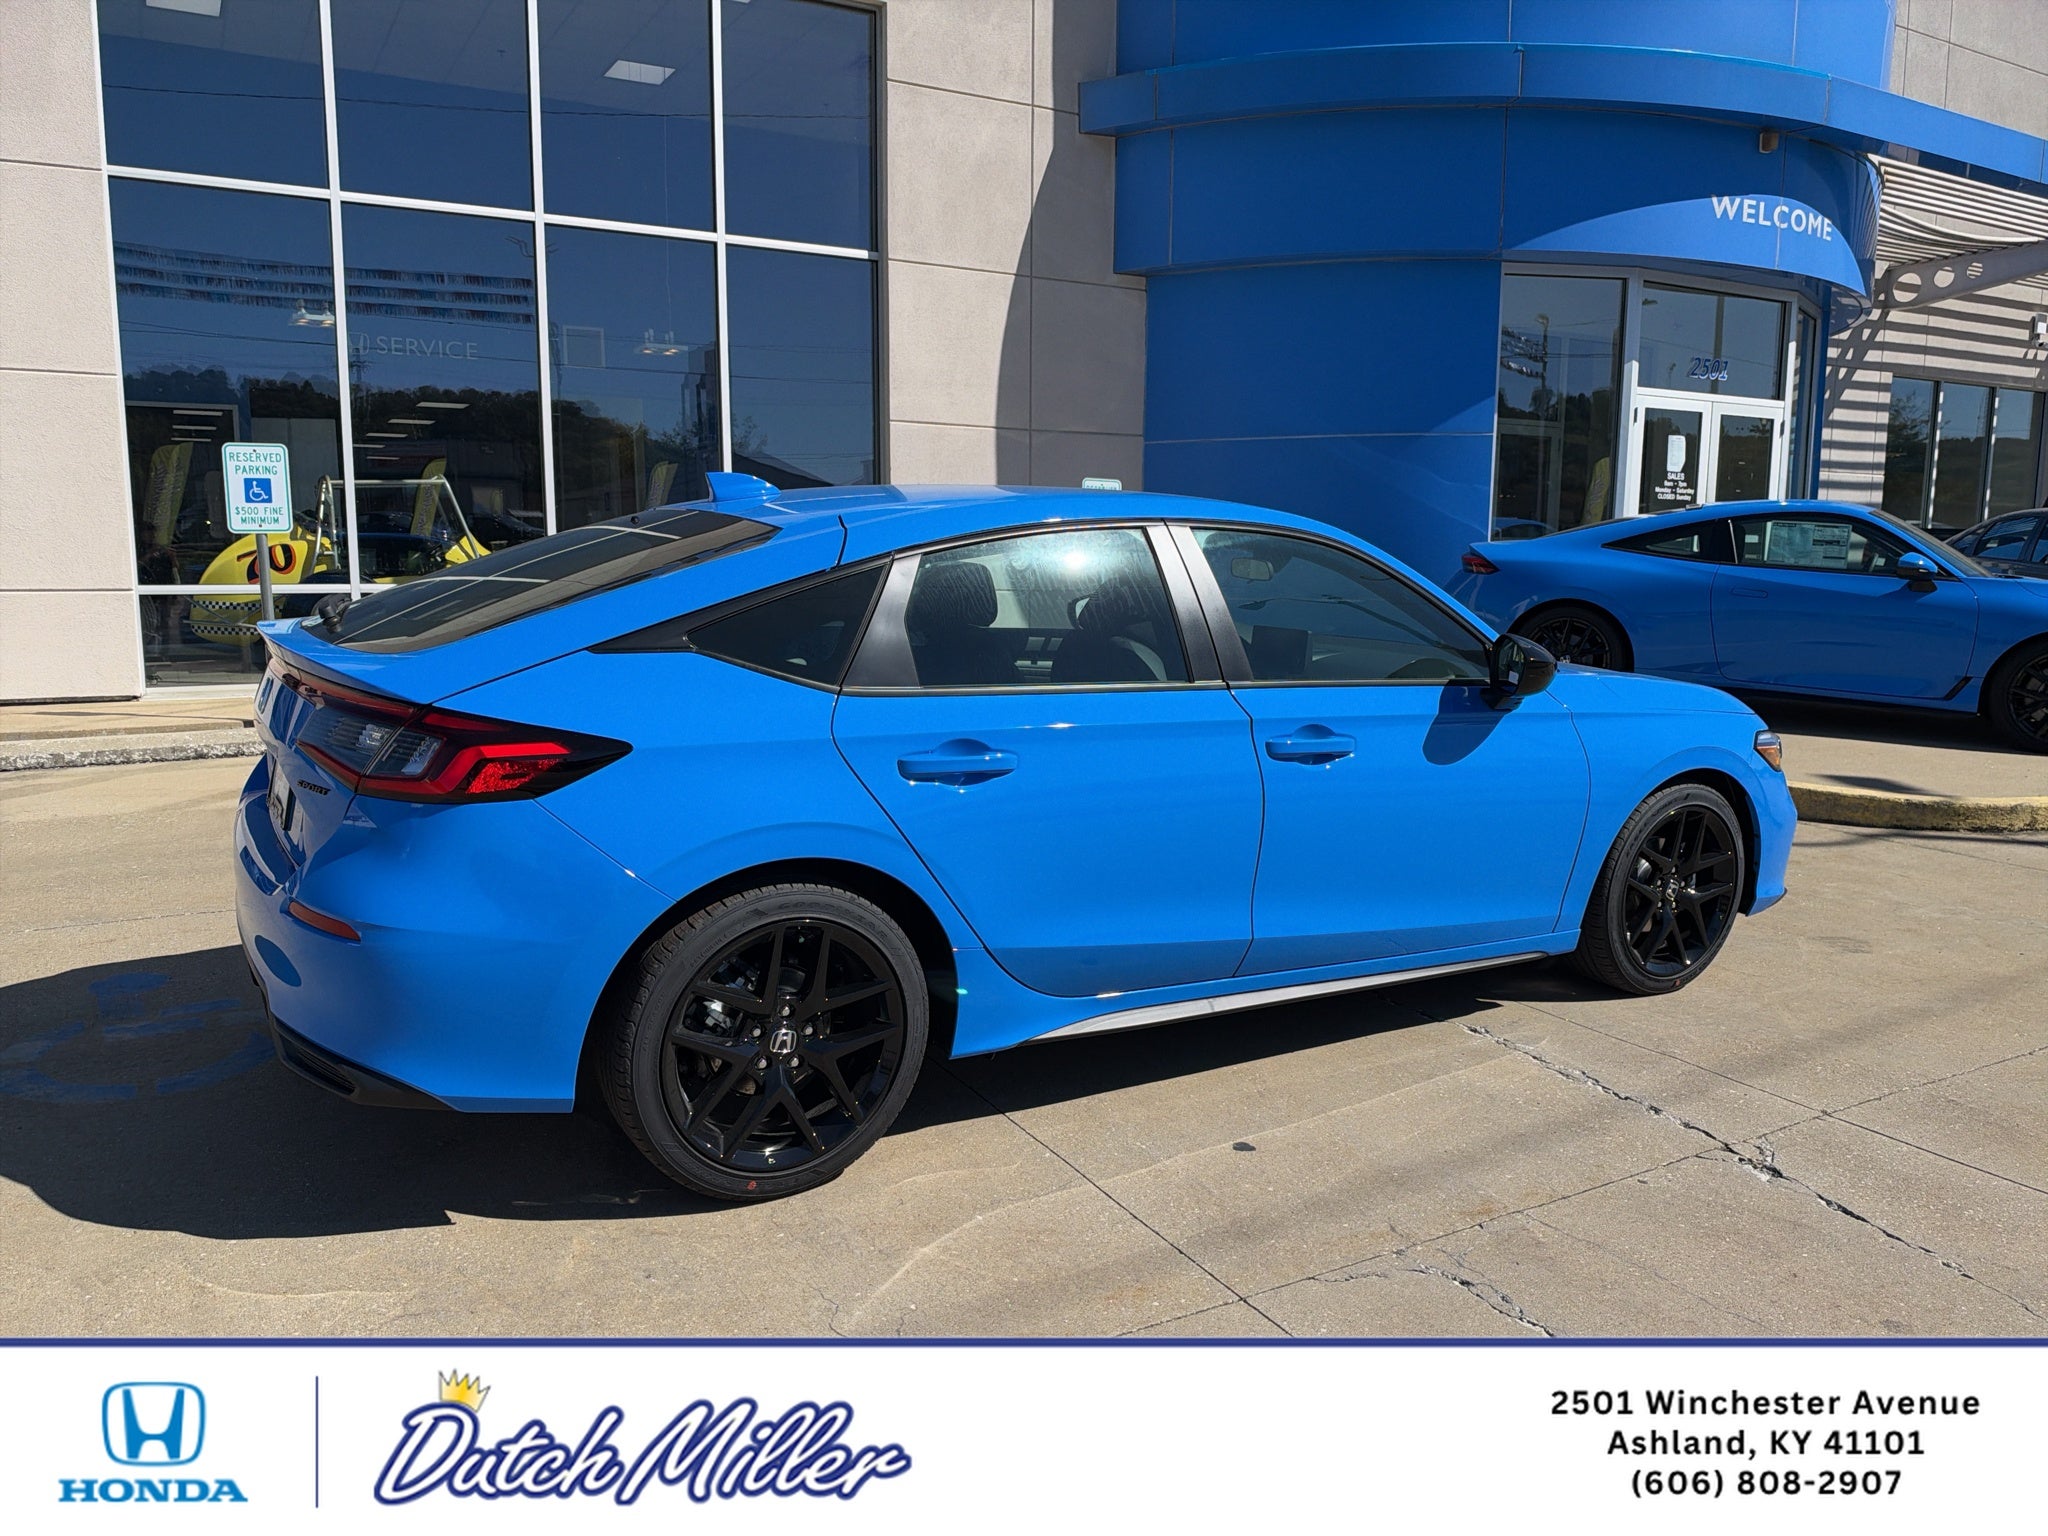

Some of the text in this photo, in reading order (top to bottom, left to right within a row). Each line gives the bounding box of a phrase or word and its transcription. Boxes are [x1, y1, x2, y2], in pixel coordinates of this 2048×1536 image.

[1711, 196, 1832, 241] WELCOME
[376, 335, 479, 360] SERVICE
[1688, 357, 1729, 381] 2501
[229, 452, 282, 463] RESERVED
[235, 465, 278, 476] PARKING
[1667, 472, 1685, 480] SALES
[235, 506, 284, 516] $500 FINE
[240, 516, 280, 525] MINIMUM
[297, 779, 331, 796] SPORT
